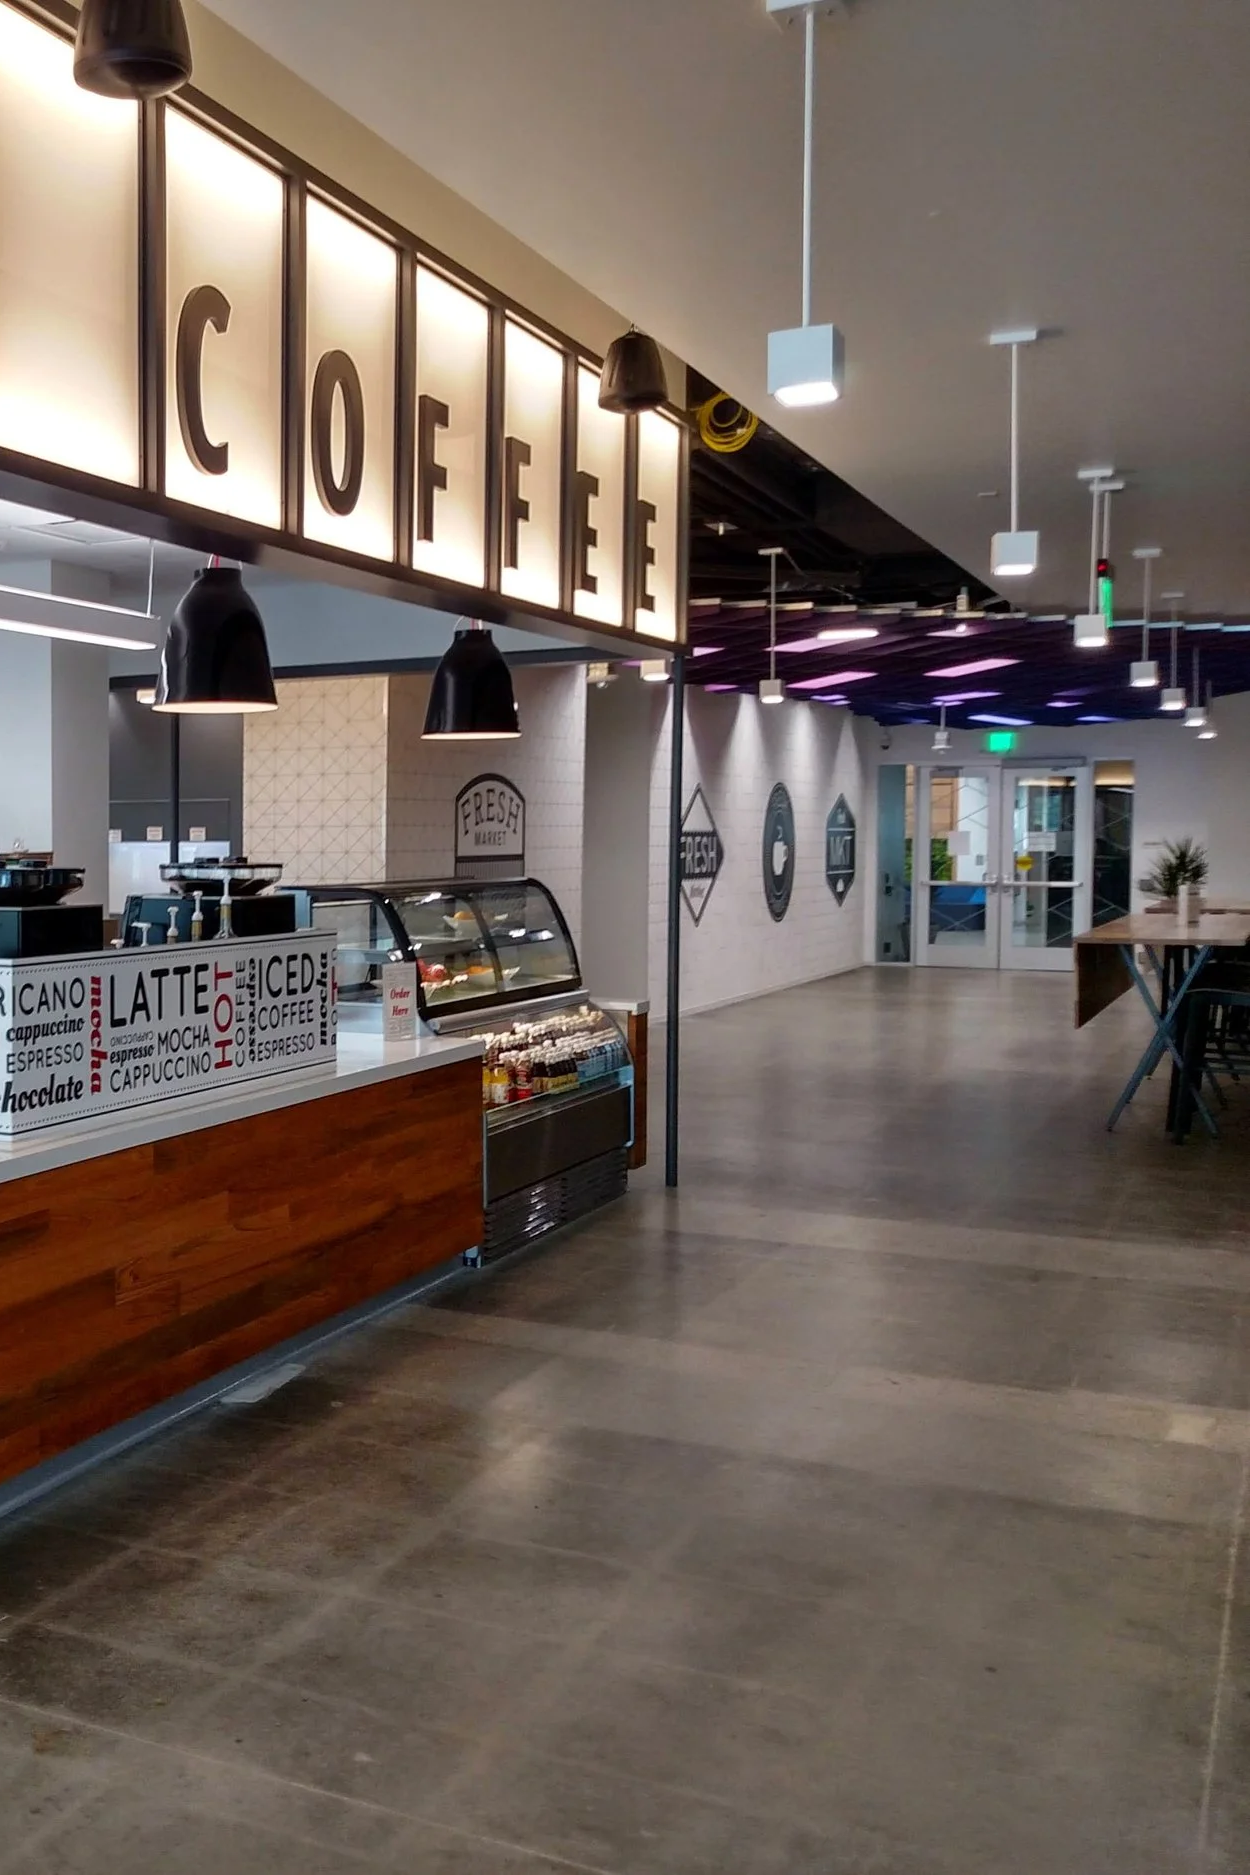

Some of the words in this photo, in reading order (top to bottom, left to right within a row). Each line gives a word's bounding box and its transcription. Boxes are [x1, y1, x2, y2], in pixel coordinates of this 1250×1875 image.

[176, 284, 656, 613] COFFEE
[461, 787, 521, 836] FRESH
[473, 830, 507, 847] MARKET
[110, 963, 210, 1028] LATTE
[258, 953, 314, 1000] ICED
[390, 987, 410, 999] Order
[214, 961, 234, 1069] HOT
[235, 959, 246, 1068] COFFEE
[246, 957, 256, 1064] espresso
[257, 999, 314, 1031] COFFEE
[316, 951, 328, 1046] mocha
[392, 1005, 408, 1017] Here
[6, 1013, 86, 1047] cappuccino
[90, 976, 108, 1095] mocha
[157, 1023, 211, 1056] MOCHA
[257, 1032, 315, 1062] ESPRESSO
[6, 1042, 85, 1074] ESPRESSO
[110, 1044, 155, 1068] espresso
[110, 1051, 211, 1093] CAPPUCCINO
